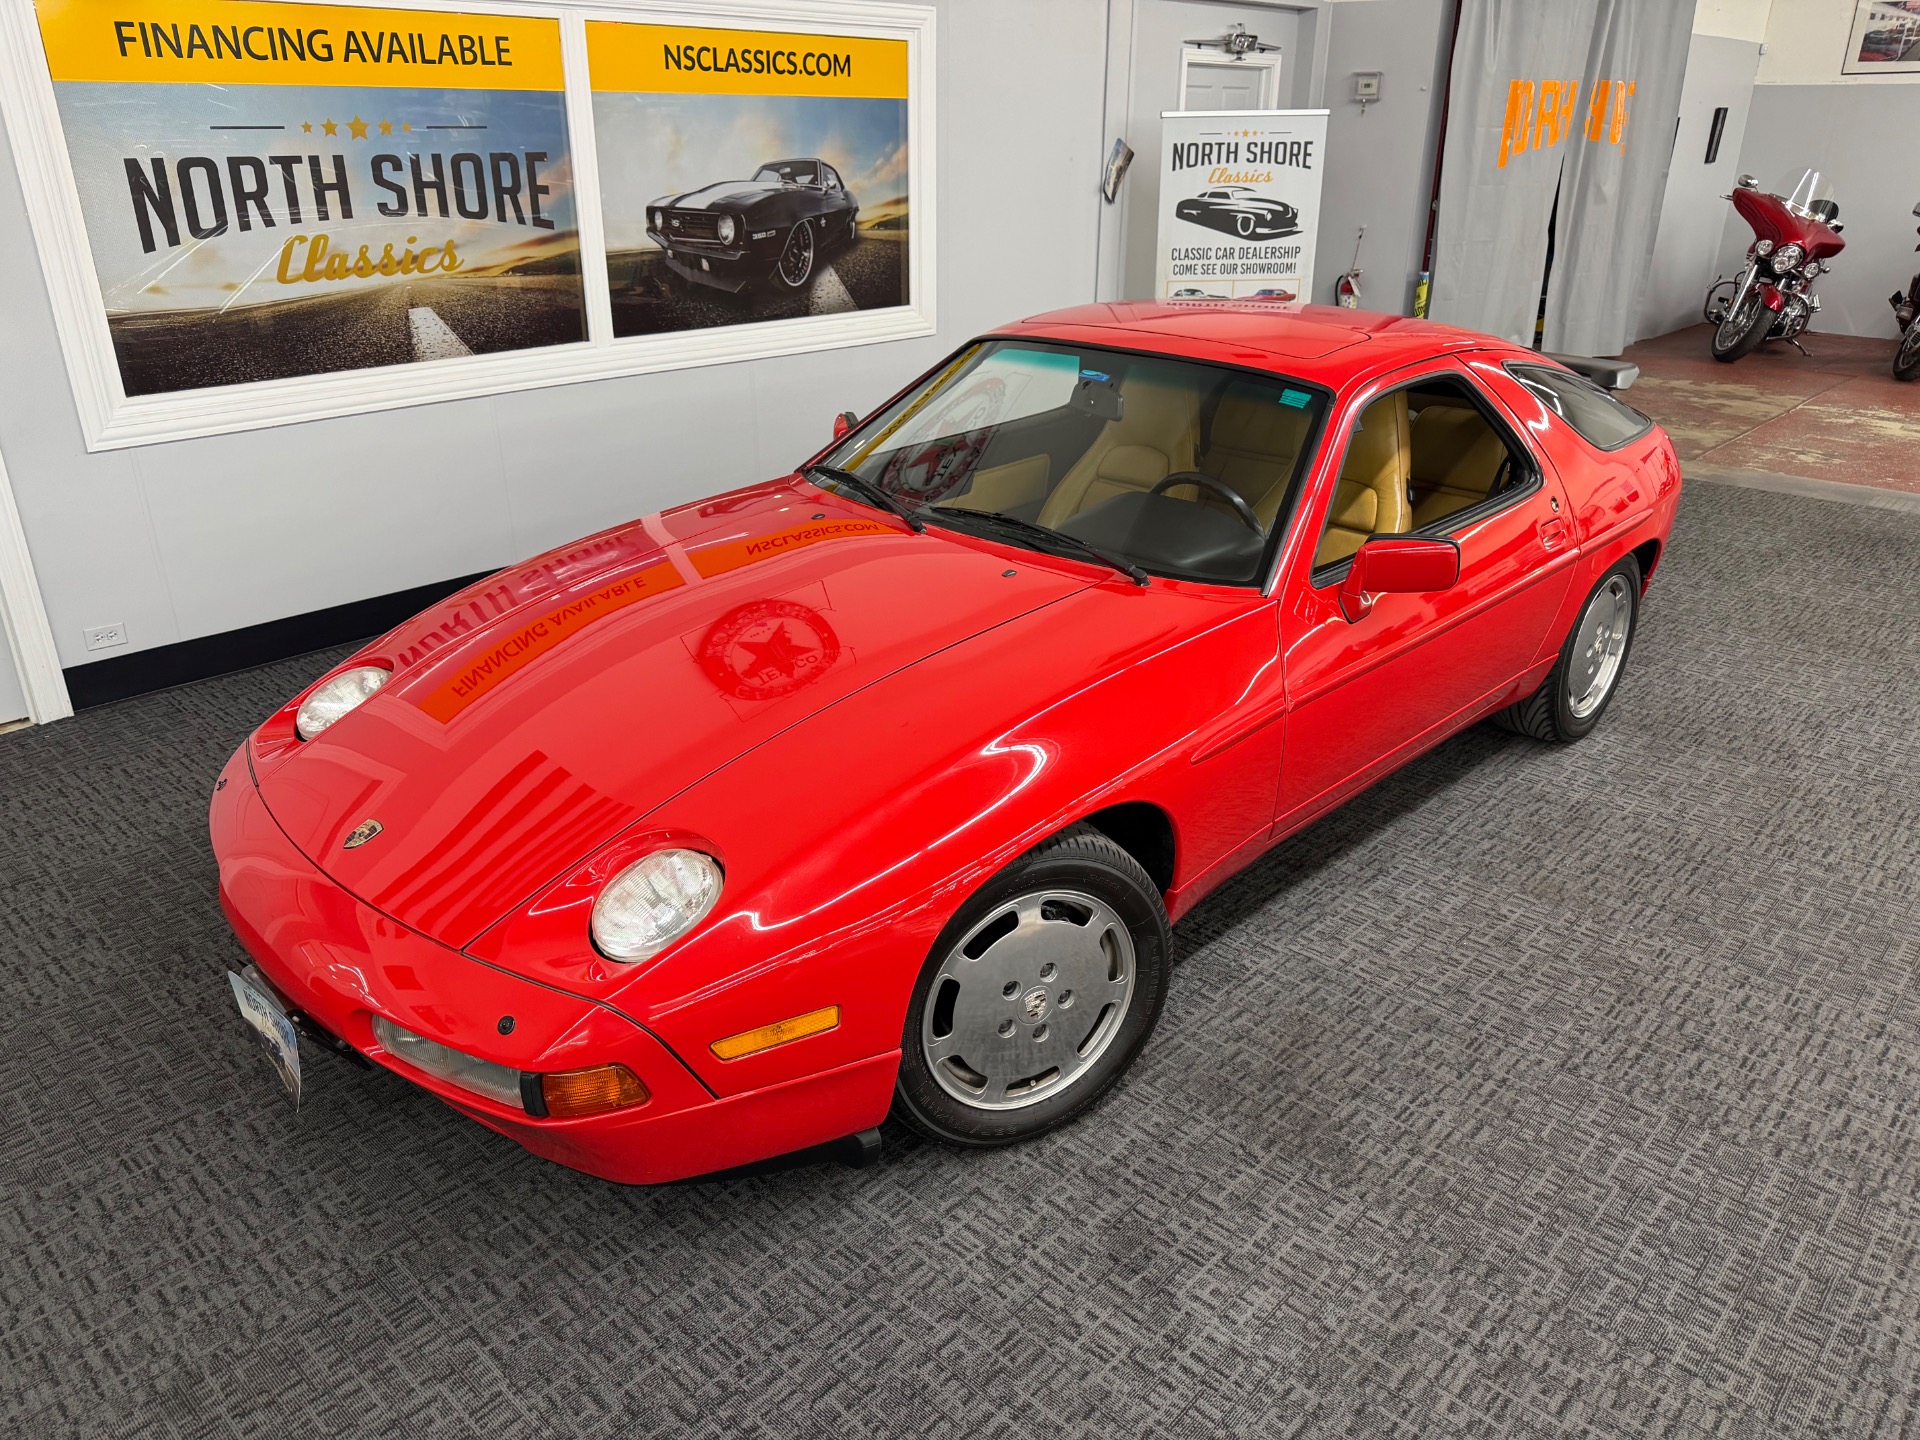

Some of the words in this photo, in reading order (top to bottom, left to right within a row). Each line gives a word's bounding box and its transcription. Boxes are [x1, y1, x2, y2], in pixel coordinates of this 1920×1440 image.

[114, 20, 334, 63] FINANCING
[343, 30, 513, 67] AVAILABLE
[663, 44, 852, 77] NSCLASSICS.COM
[1171, 141, 1239, 171] NORTH
[1246, 140, 1314, 170] SHORE
[1208, 167, 1274, 184] Classics
[123, 153, 355, 254] NORTH
[370, 151, 556, 231] SHORE
[276, 233, 465, 285] Classics
[1171, 247, 1213, 262] CLASSIC
[1215, 247, 1236, 261] CAR
[1238, 246, 1301, 260] DEALERSHIP
[1172, 263, 1199, 276] COME
[1200, 263, 1217, 275] SEE
[1219, 262, 1238, 275] OUR
[1240, 262, 1297, 274] SHOWROOM!
